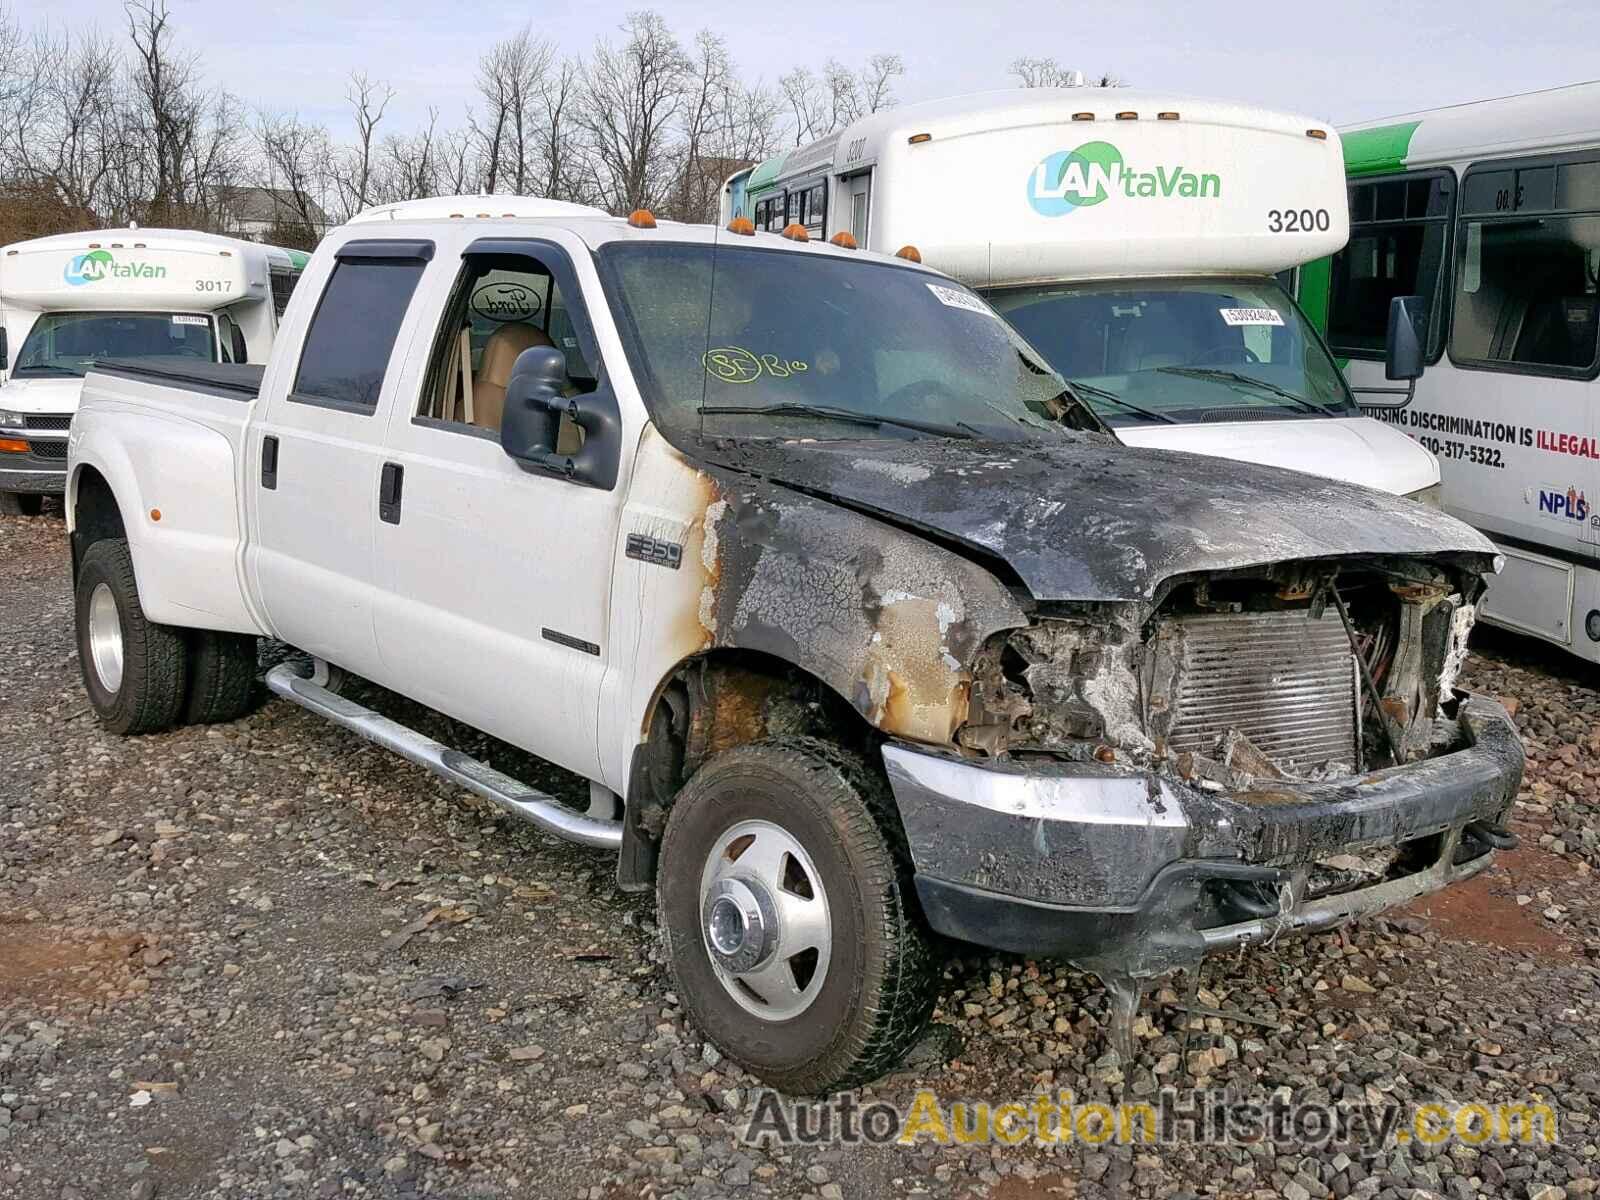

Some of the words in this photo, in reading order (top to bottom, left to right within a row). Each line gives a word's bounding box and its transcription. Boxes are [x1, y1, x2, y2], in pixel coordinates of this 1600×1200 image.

[1033, 161, 1221, 198] LANtaVan
[1269, 208, 1331, 234] 3200
[67, 259, 166, 279] LANtaVan
[195, 280, 232, 292] 3017
[1411, 410, 1515, 443] DISCRIMINATION
[1520, 427, 1533, 447] IS
[1539, 490, 1586, 521] NPLS
